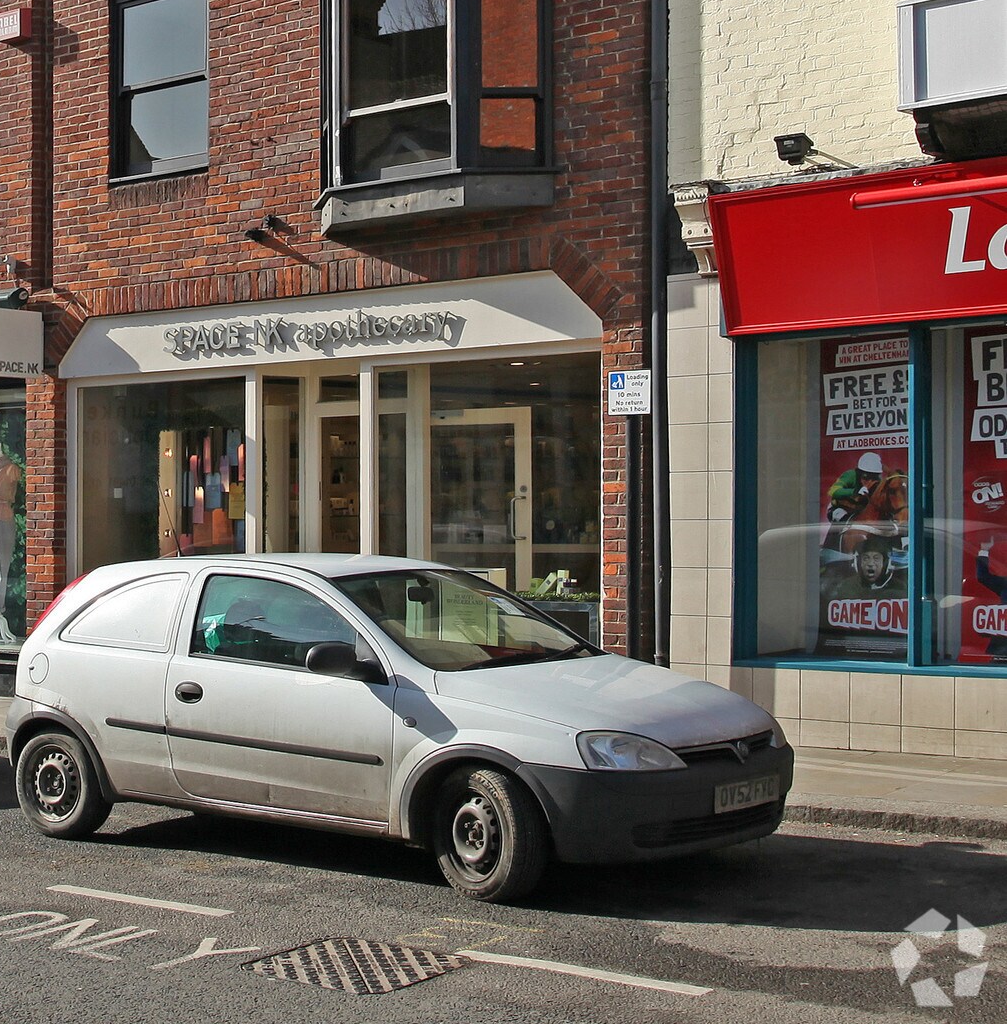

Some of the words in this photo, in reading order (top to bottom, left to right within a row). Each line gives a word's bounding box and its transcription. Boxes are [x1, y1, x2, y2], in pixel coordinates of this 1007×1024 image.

[163, 321, 242, 353] SPACE
[253, 317, 285, 345] NK
[296, 309, 450, 349] apothecary
[848, 344, 871, 354] GREAT
[874, 341, 897, 351] PLACE
[899, 340, 908, 348] TO
[863, 350, 909, 362] CHELTENHA
[982, 338, 1007, 371] F
[829, 373, 887, 399] FREE
[986, 372, 1007, 402] B
[853, 398, 873, 409] BET
[876, 396, 897, 407] FOR
[837, 440, 846, 448] AT
[972, 482, 1004, 504] ON!
[831, 602, 872, 625] GAME
[877, 601, 908, 629] ON
[720, 782, 752, 807] OV52
